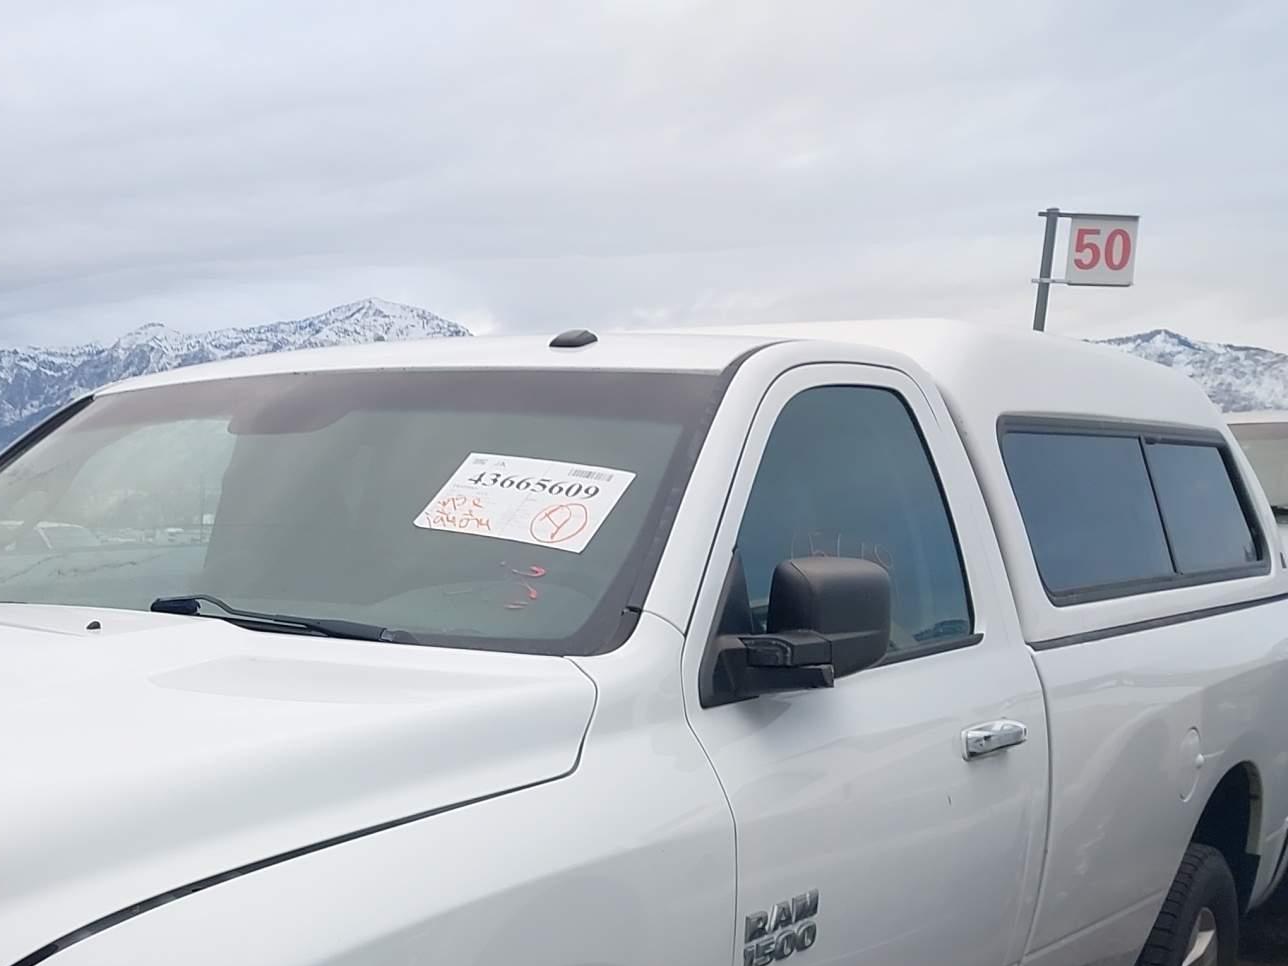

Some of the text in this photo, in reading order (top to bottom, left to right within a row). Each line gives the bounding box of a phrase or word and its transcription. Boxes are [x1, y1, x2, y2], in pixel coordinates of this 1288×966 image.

[1074, 228, 1132, 271] 50
[468, 471, 601, 500] 43665609
[744, 887, 820, 944] RAM
